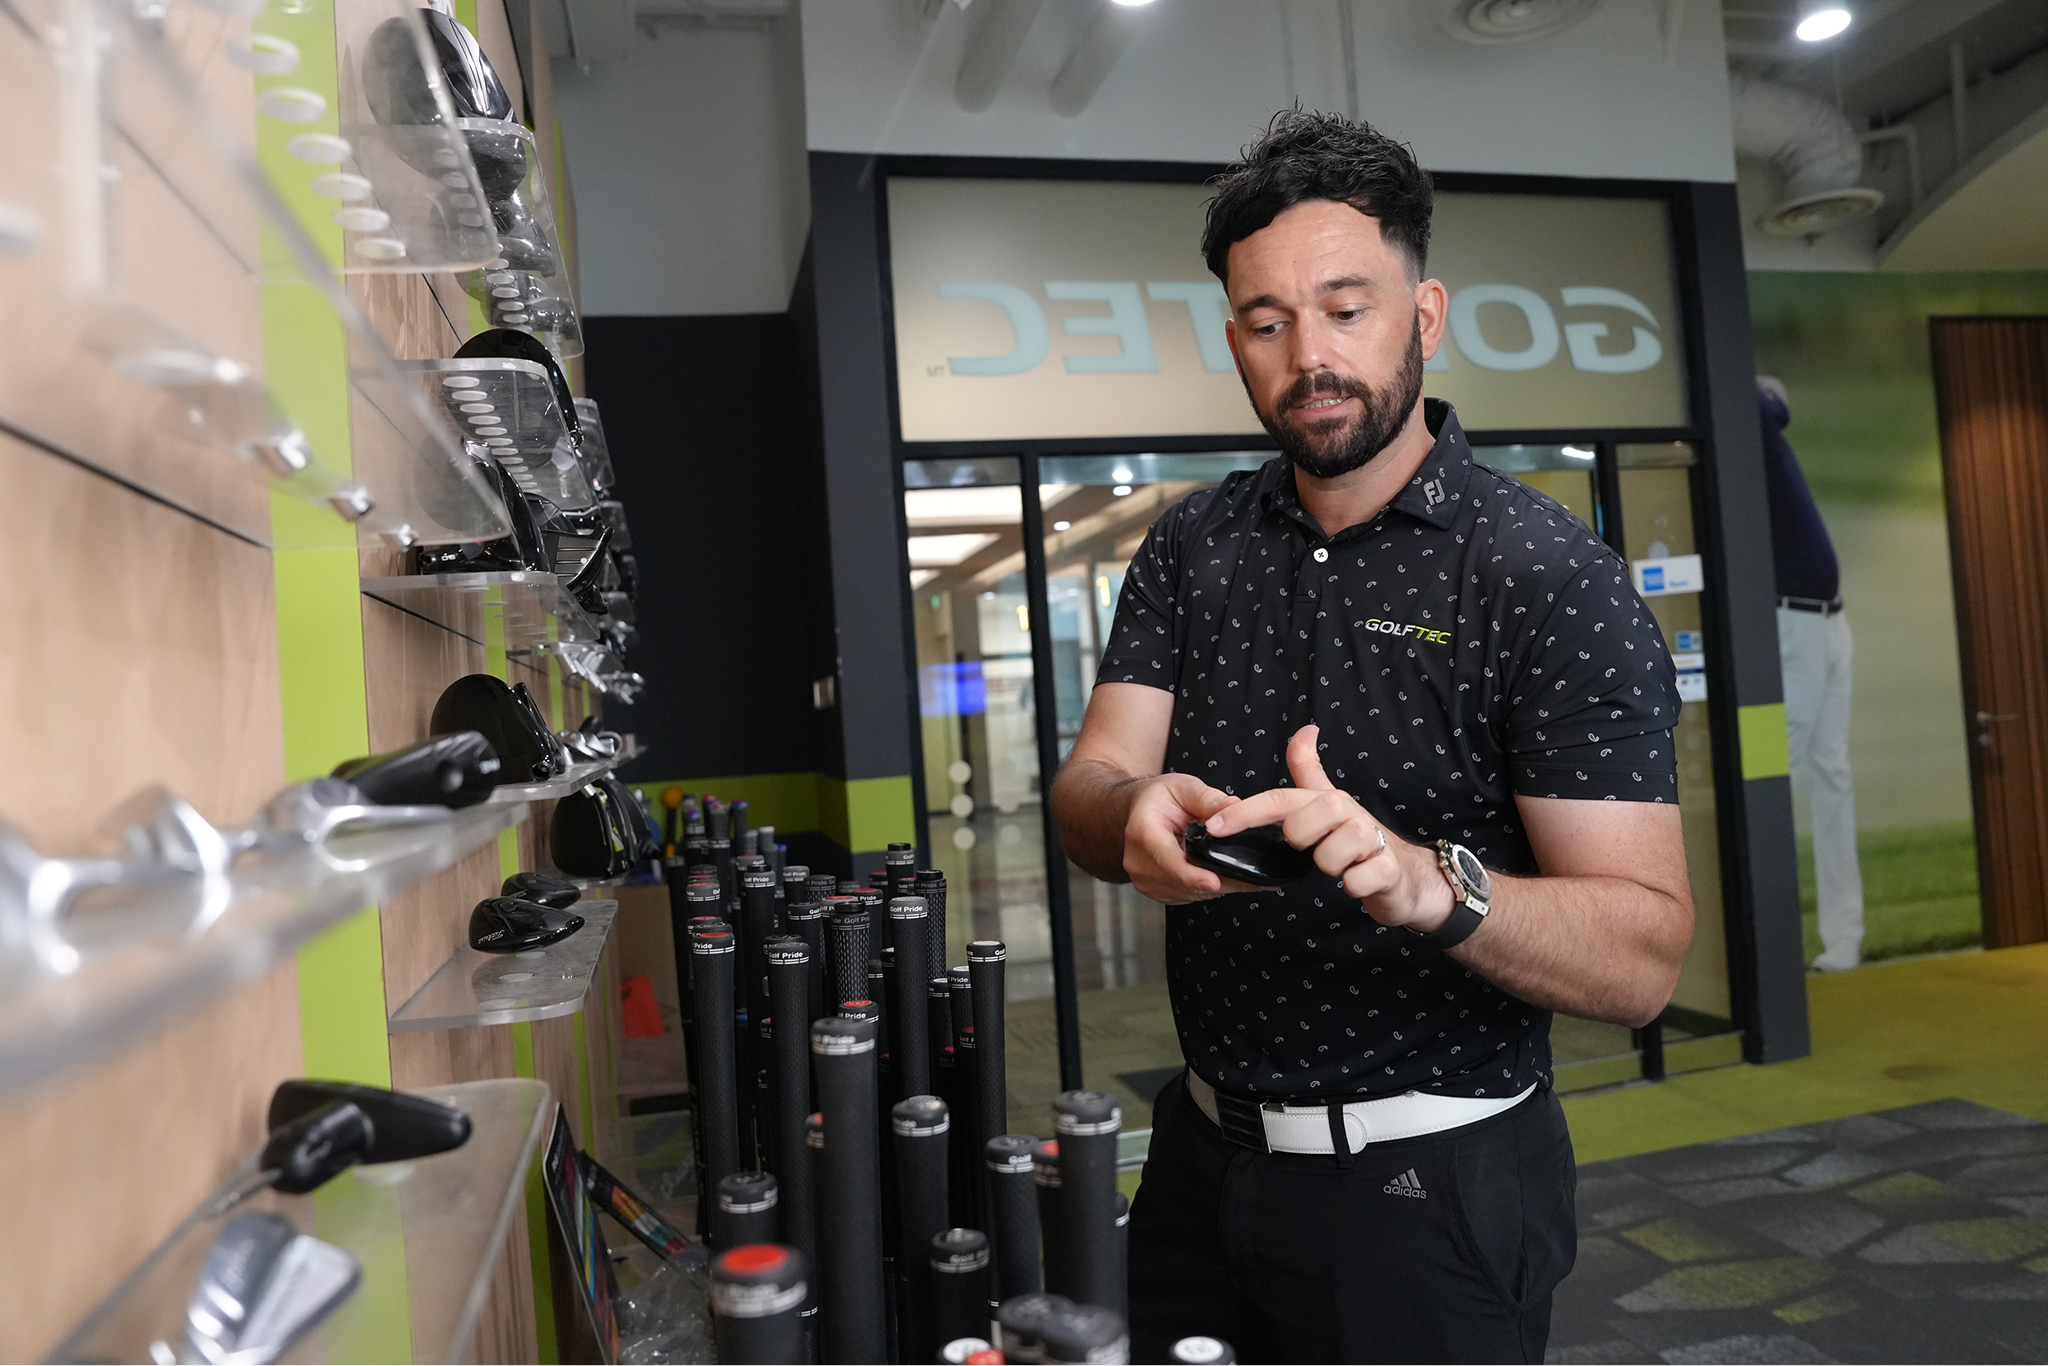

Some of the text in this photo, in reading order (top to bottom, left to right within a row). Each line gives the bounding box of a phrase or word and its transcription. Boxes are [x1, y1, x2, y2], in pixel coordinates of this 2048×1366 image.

[1364, 618, 1452, 645] GOLFTEC
[782, 951, 803, 959] Pride
[1383, 1184, 1427, 1199] adidas
